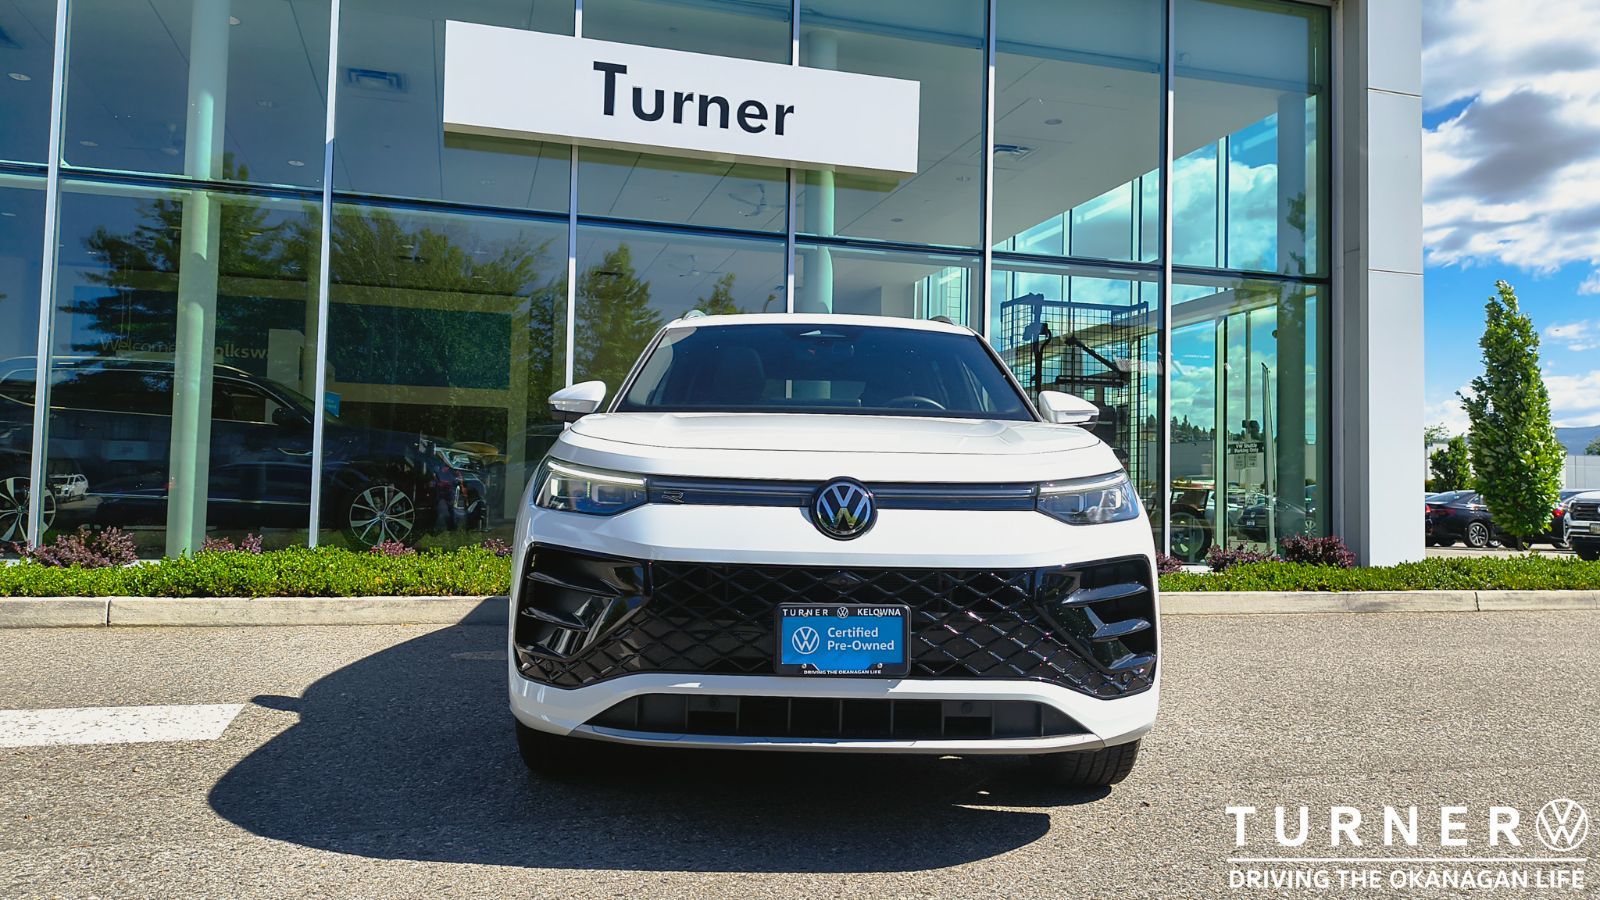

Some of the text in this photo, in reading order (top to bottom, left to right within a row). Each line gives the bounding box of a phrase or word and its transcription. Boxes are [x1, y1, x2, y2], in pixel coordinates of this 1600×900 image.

[593, 60, 795, 136] Turner
[214, 343, 269, 359] olksw
[782, 608, 829, 616] TURNER
[857, 608, 901, 616] KELOWNA
[827, 627, 879, 638] Certified
[827, 640, 895, 651] Pre-Owned
